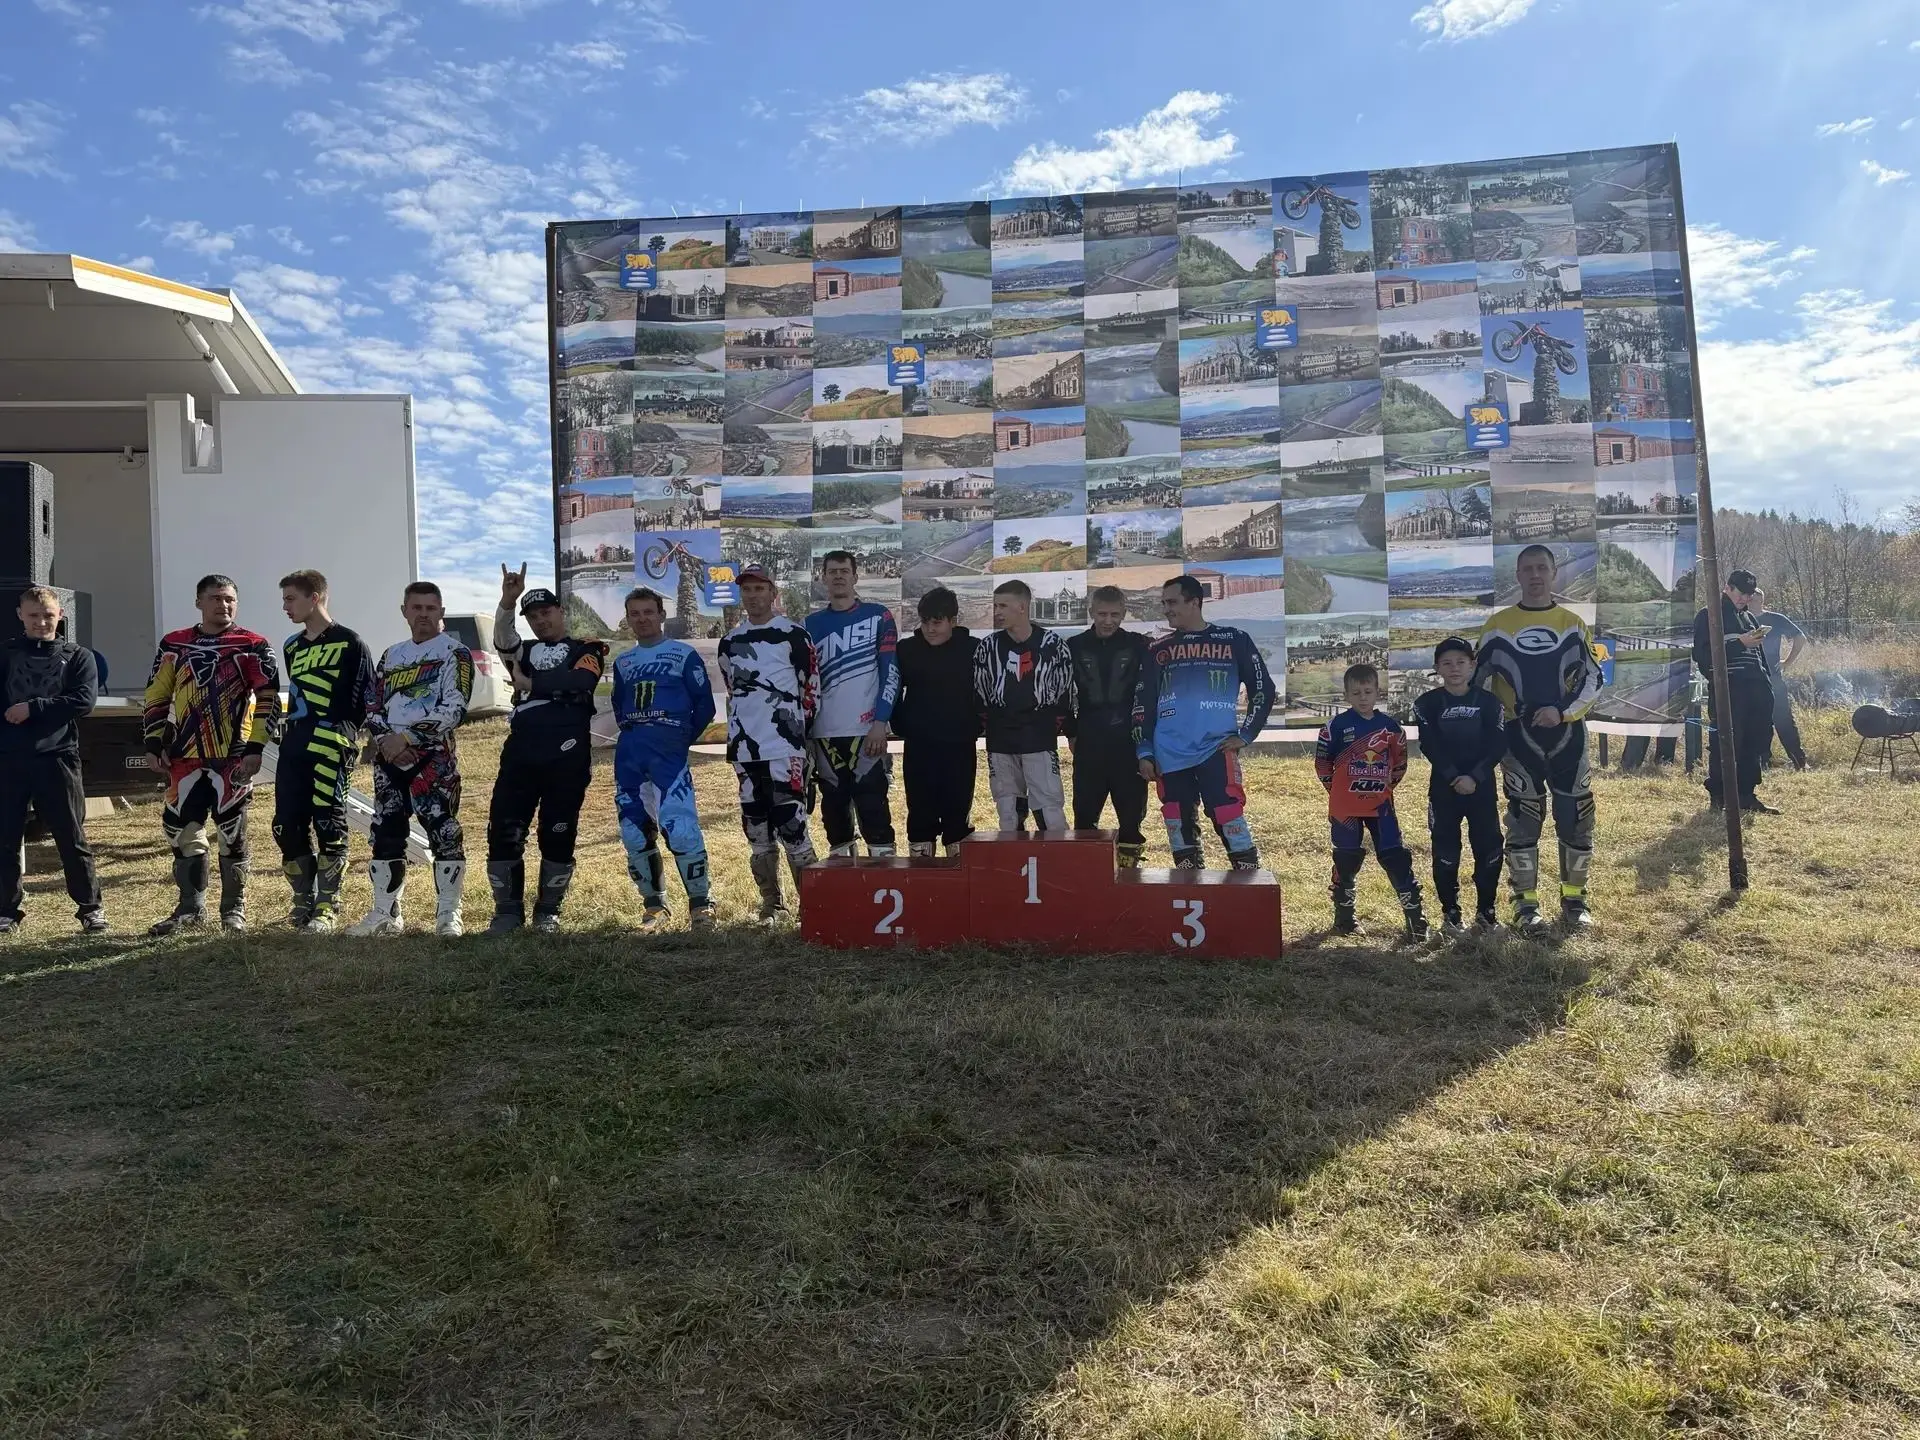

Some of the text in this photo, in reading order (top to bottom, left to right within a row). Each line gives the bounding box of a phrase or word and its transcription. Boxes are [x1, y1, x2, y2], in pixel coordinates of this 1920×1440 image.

[1168, 643, 1233, 660] YAMAHA
[1441, 706, 1481, 719] LEATT
[1348, 764, 1371, 776] Red
[1349, 778, 1387, 793] KTM
[1021, 856, 1042, 904] 1
[1172, 900, 1206, 948] 3
